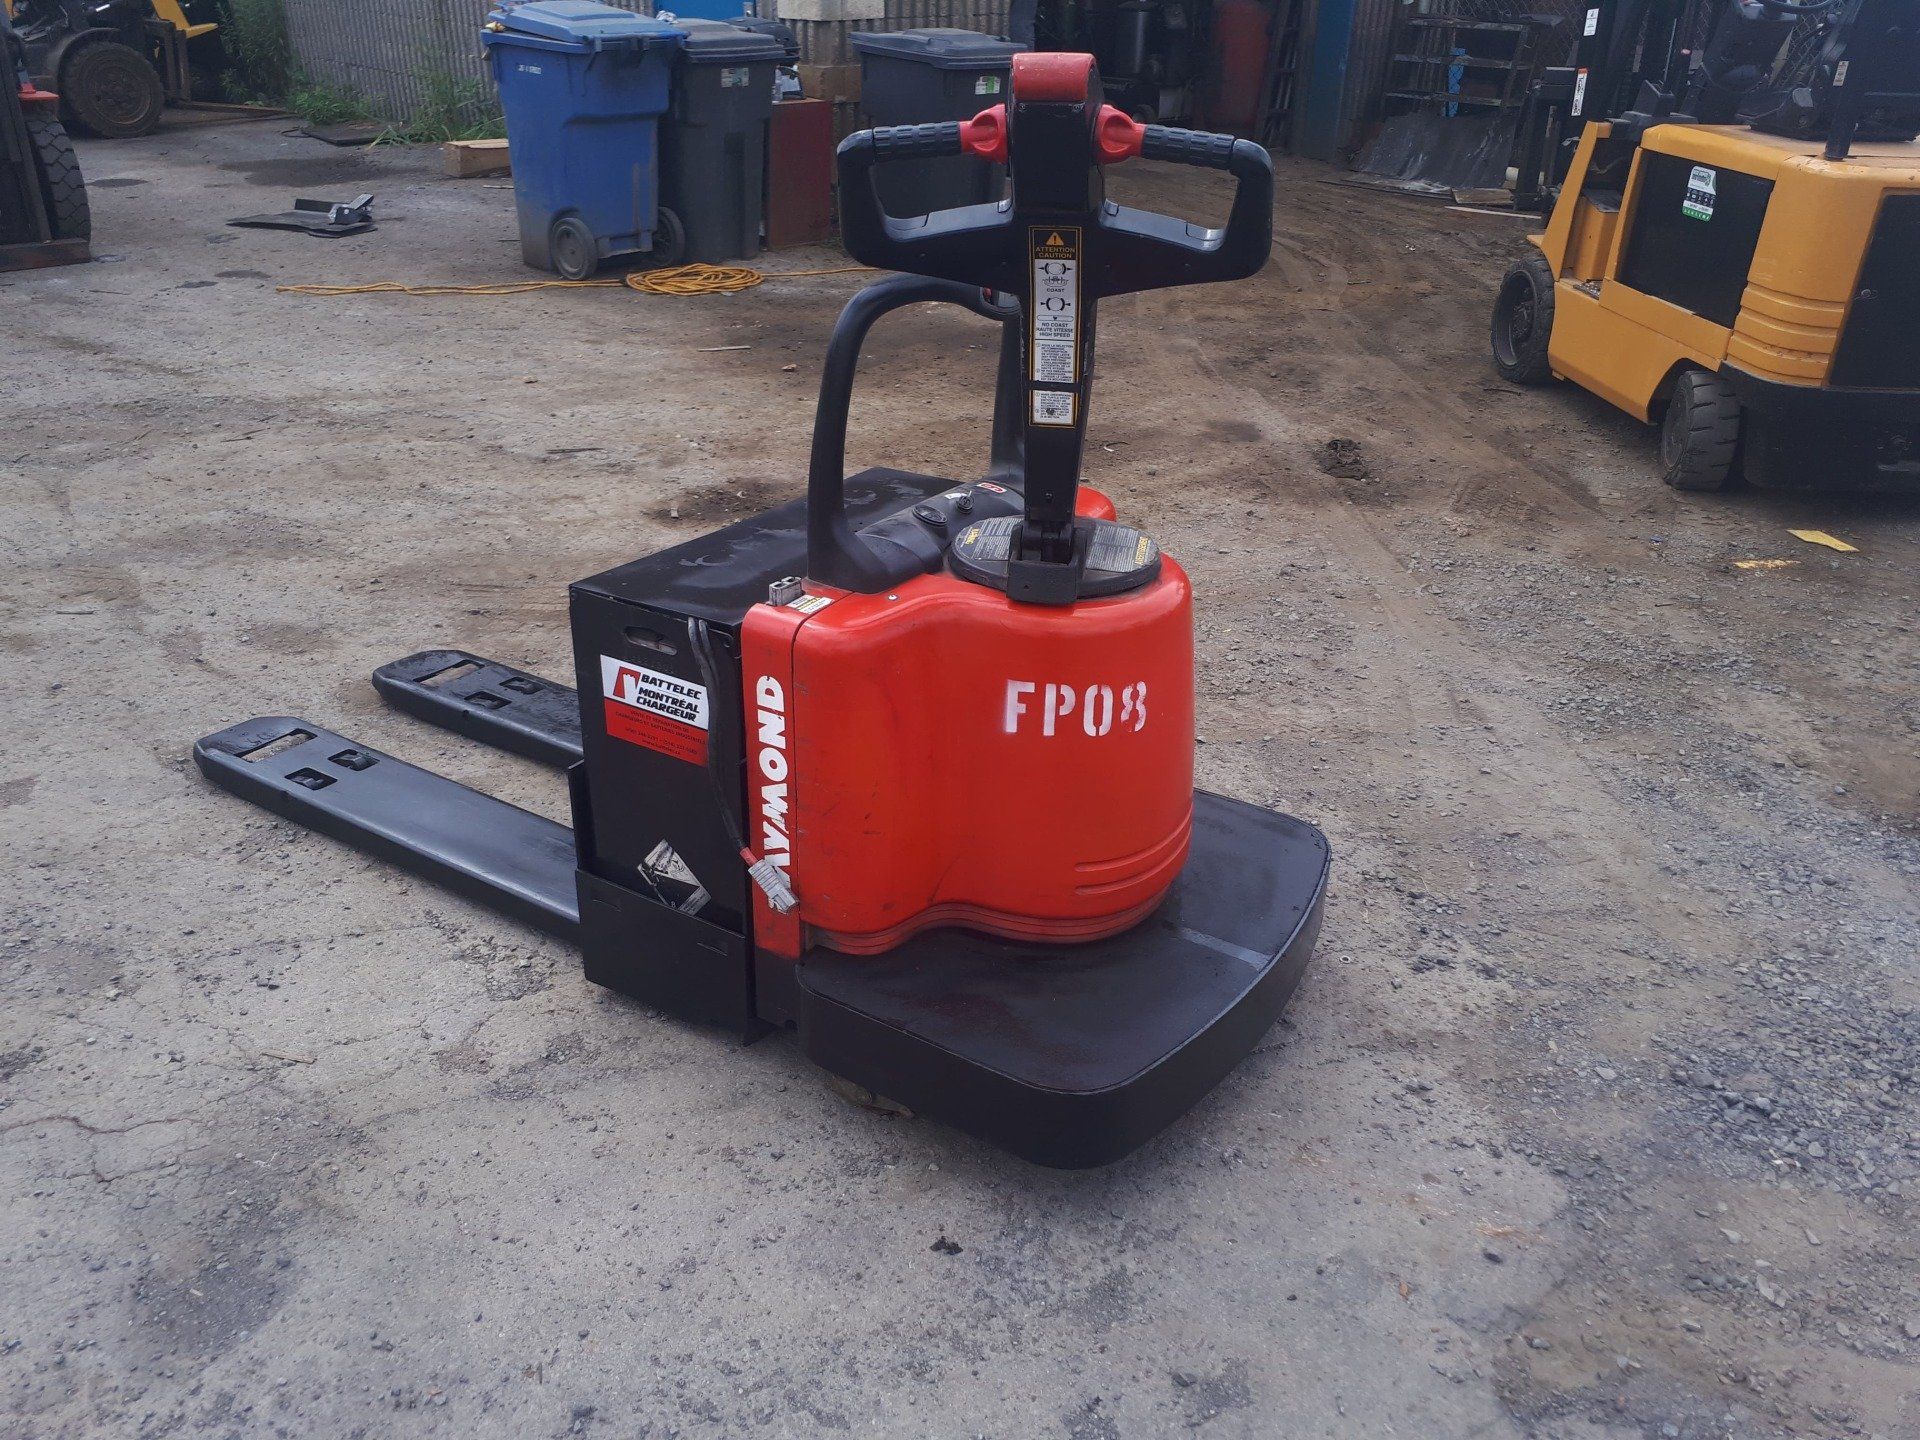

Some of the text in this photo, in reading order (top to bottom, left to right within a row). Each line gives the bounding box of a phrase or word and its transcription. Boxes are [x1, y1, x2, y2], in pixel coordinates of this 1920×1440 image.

[640, 673, 702, 700] BATTELEC
[636, 696, 697, 722] CHARGEUR
[638, 687, 700, 714] MONTRÉAL
[1003, 679, 1147, 737] FP08
[756, 675, 792, 914] AYMOND
